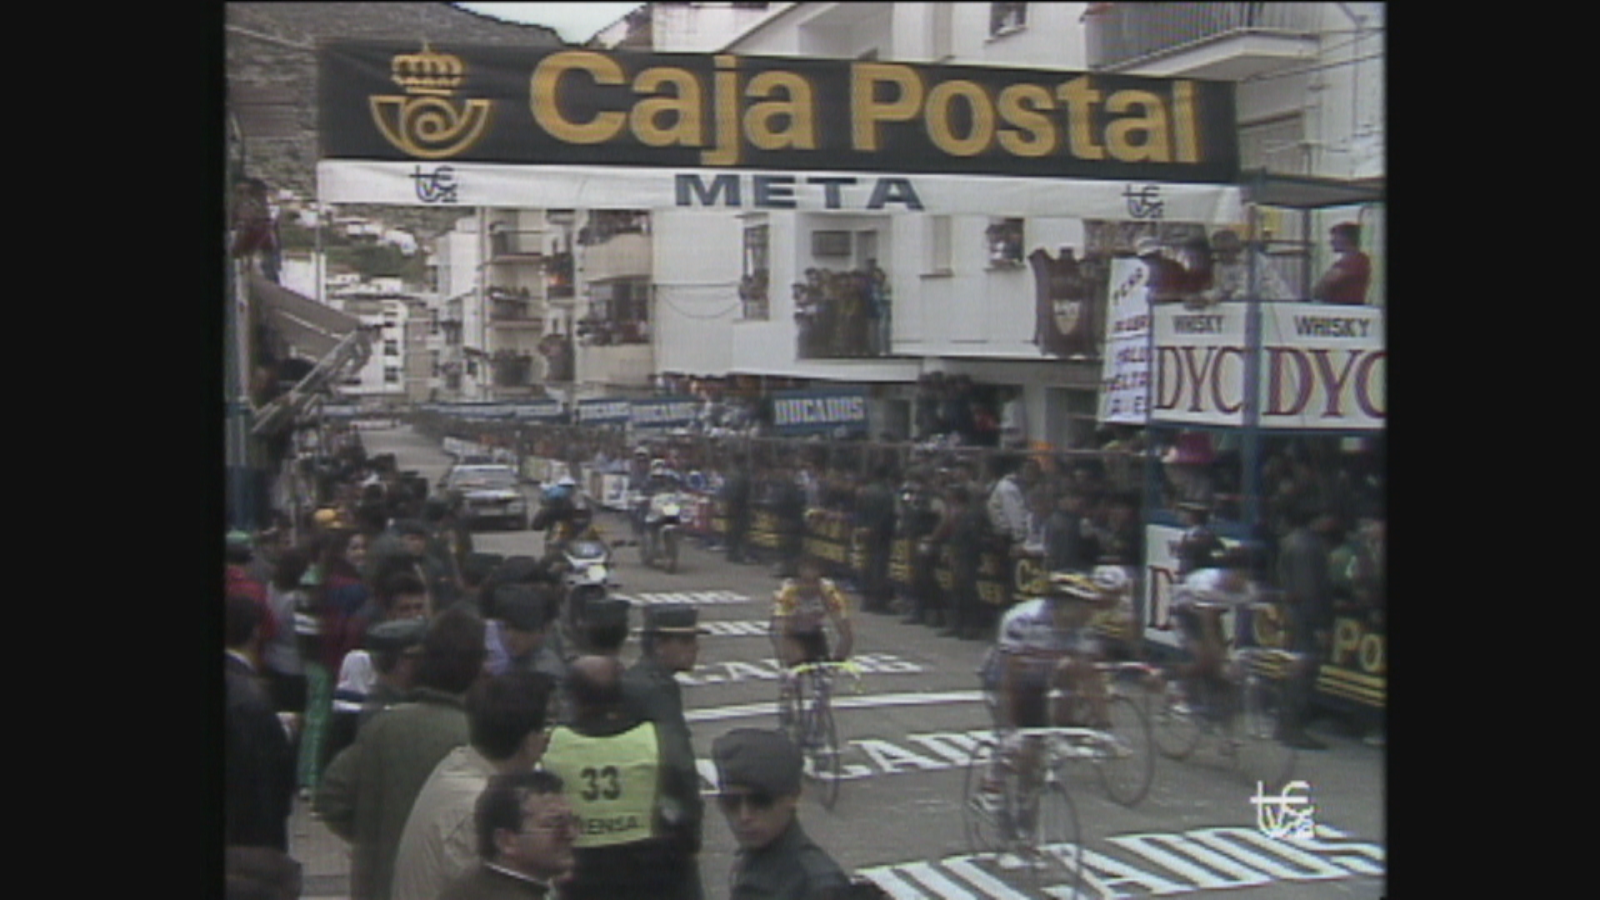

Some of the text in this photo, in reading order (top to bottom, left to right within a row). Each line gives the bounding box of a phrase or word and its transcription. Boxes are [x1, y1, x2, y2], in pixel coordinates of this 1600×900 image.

[530, 50, 1200, 165] Caja Postal
[674, 174, 924, 210] META
[1172, 314, 1224, 334] WHISKY
[1294, 315, 1370, 337] WHISKY
[1154, 346, 1244, 414] DYC
[1262, 346, 1386, 419] DYC
[580, 766, 621, 802] 33
[855, 827, 1386, 900] UCADOS
